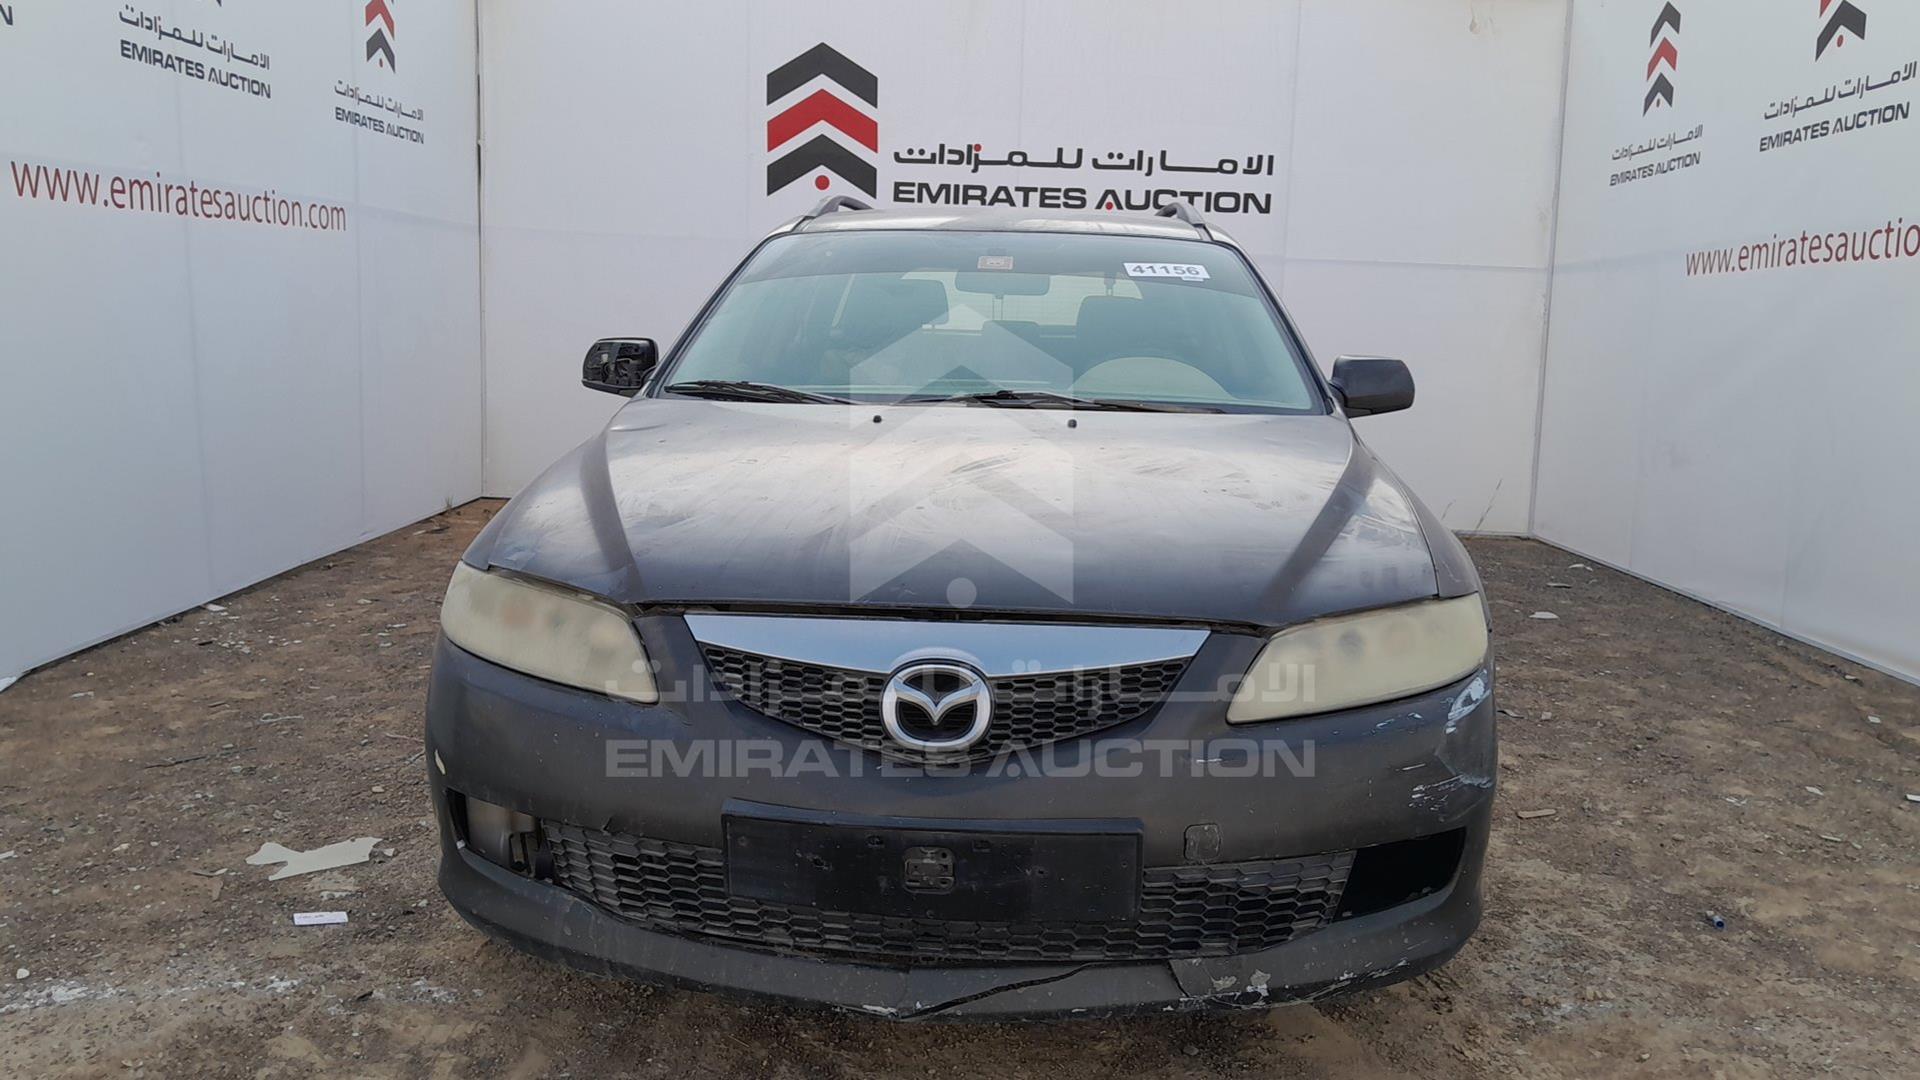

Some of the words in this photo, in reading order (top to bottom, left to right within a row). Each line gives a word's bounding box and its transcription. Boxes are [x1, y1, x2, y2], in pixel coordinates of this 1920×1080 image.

[120, 39, 205, 80] EMIRATES
[207, 66, 271, 99] AUCTION
[334, 106, 385, 134] EMIRATES
[386, 122, 425, 145] AUCTION
[1759, 119, 1830, 152] EMIRATES
[1831, 101, 1910, 135] AUCTION
[1609, 163, 1655, 187] EMIRATES
[1654, 151, 1701, 176] AUCTION
[10, 160, 347, 232] www.emiratesauction.com
[892, 181, 1087, 210] EMIRATES
[1094, 189, 1272, 215] AUCTION
[1132, 265, 1200, 276] 41156
